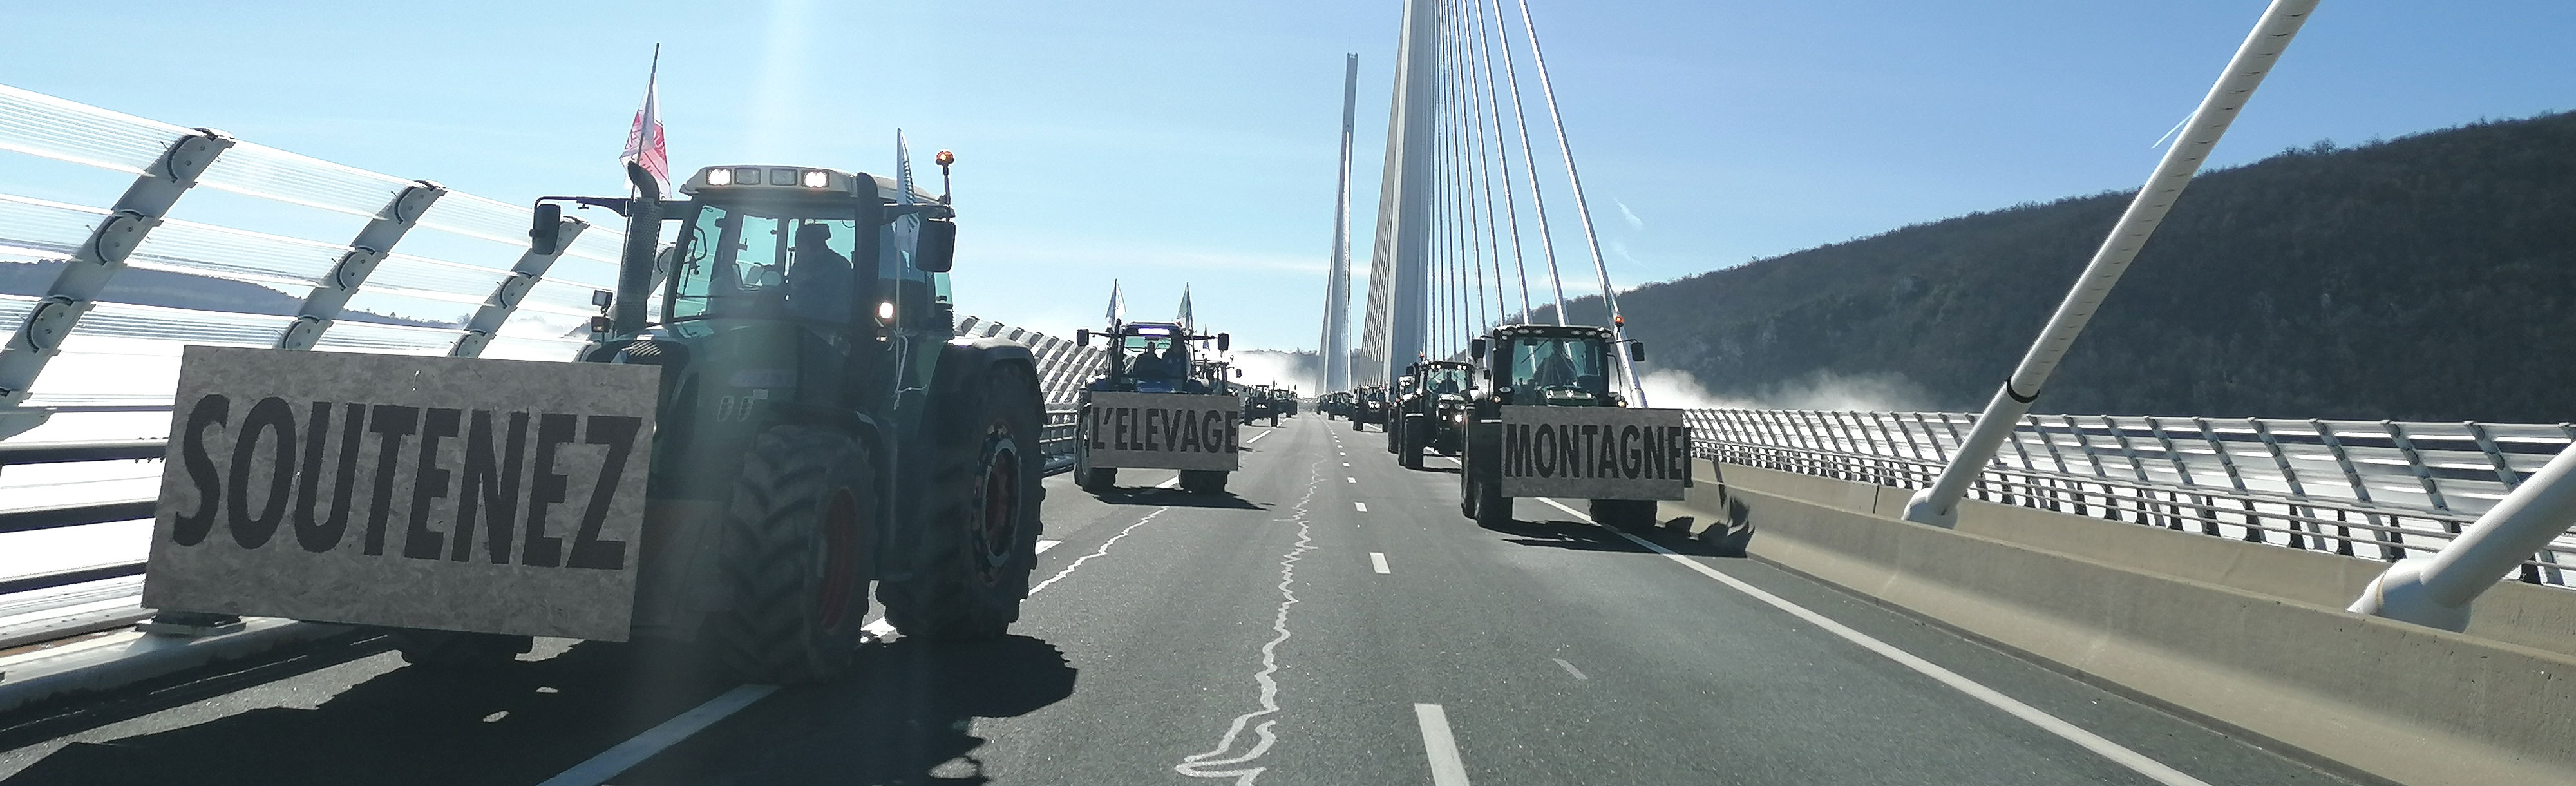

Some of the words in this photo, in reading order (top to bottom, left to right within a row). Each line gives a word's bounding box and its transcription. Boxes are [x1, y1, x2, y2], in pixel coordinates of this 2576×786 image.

[1092, 408, 1238, 453] L'ELEVAGE
[1504, 423, 1682, 479] MONTAGNE
[173, 394, 642, 570] SOUTENEZ
